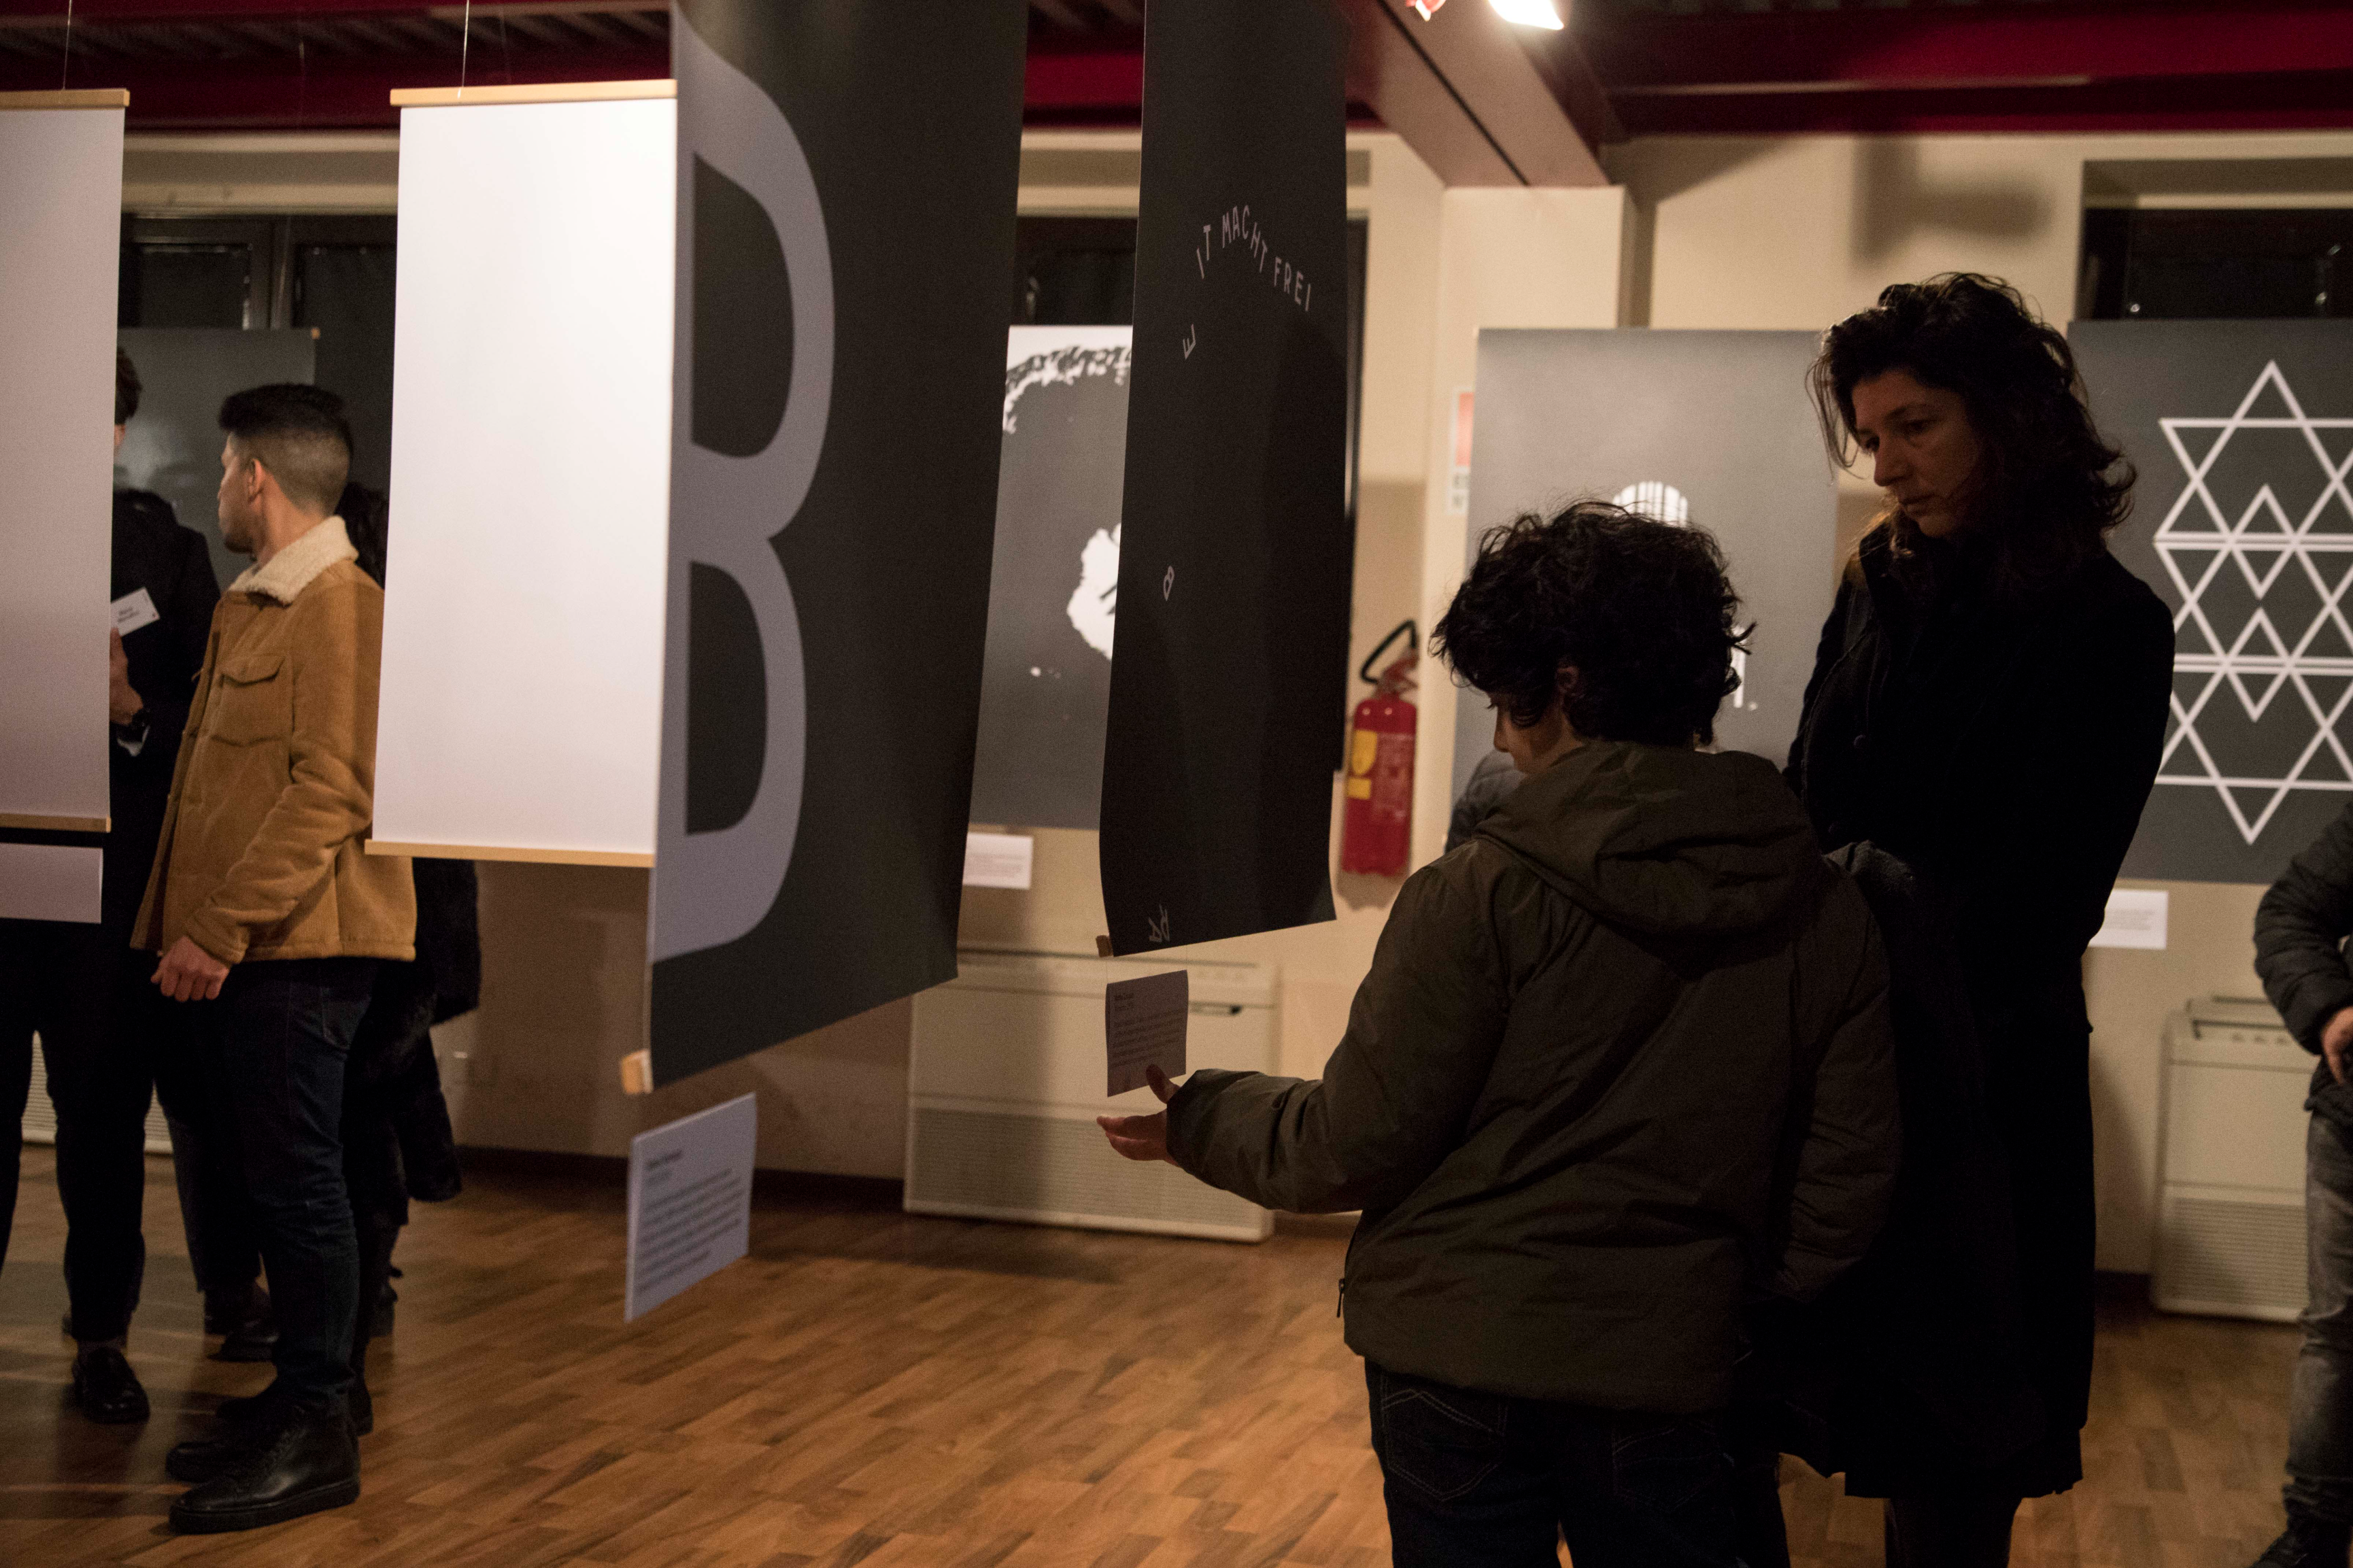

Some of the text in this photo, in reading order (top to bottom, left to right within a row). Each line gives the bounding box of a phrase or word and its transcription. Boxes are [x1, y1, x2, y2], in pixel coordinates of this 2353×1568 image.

[1222, 205, 1268, 272] MACHT
[1274, 256, 1312, 311] FREI
[1182, 324, 1197, 360] E
[651, 0, 836, 963] B
[1162, 565, 1175, 601] B
